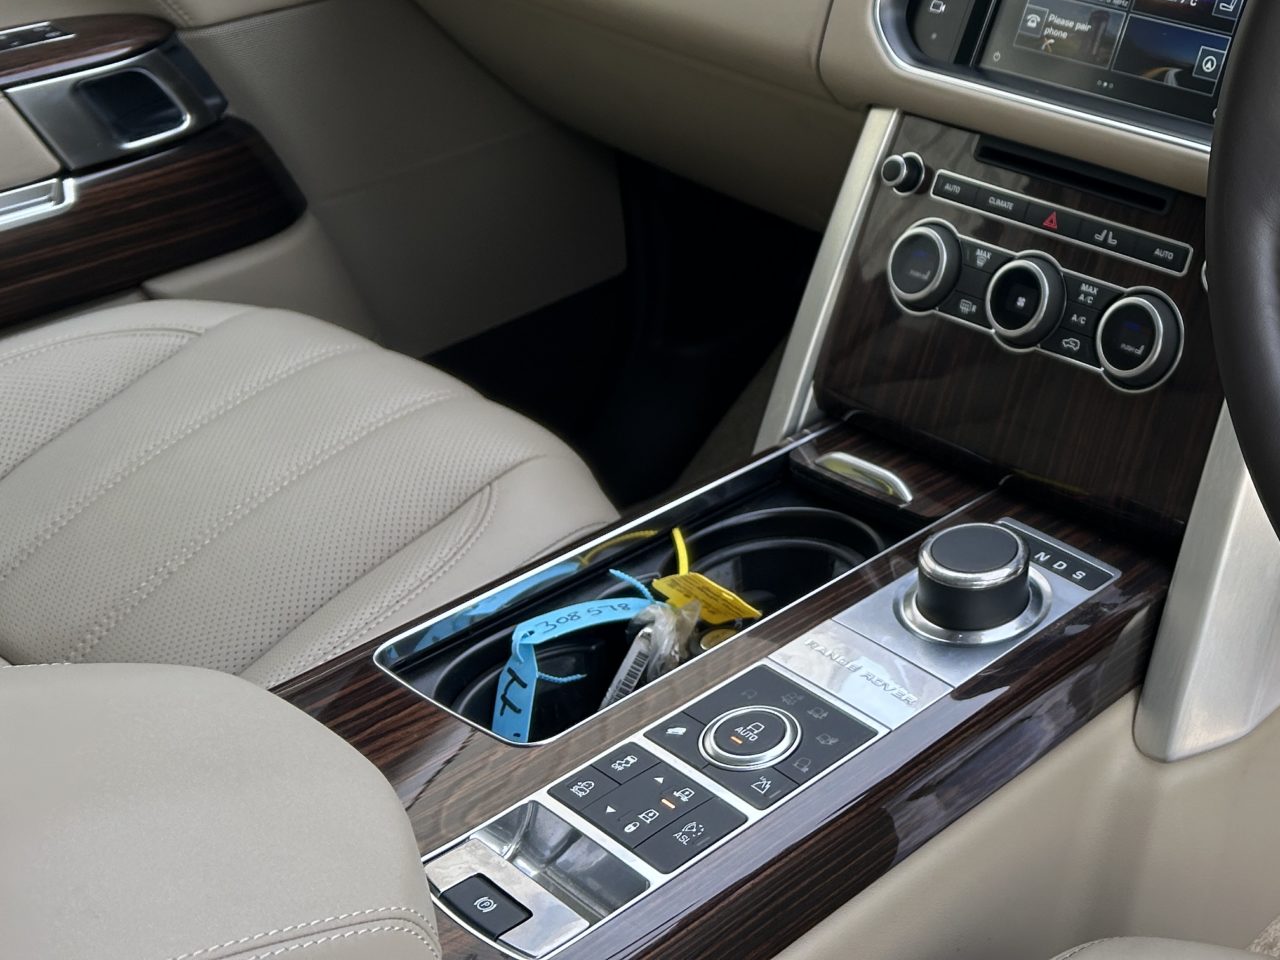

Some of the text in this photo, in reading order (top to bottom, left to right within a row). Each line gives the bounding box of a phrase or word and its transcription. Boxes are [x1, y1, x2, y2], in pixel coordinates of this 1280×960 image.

[1047, 13, 1092, 33] Please pair
[1043, 26, 1068, 39] phone
[944, 182, 961, 195] AUTO
[988, 196, 1015, 211] CLIMATE
[975, 248, 992, 260] MAX
[1154, 247, 1174, 260] AUTO
[1080, 282, 1099, 295] MAX
[1078, 293, 1094, 304] A/C
[1071, 313, 1087, 325] A/C
[1034, 551, 1087, 580] N D S
[535, 610, 582, 634] 308
[804, 640, 919, 706] RANGE ROVER
[733, 724, 760, 742] AUTO
[672, 830, 692, 846] ASL
